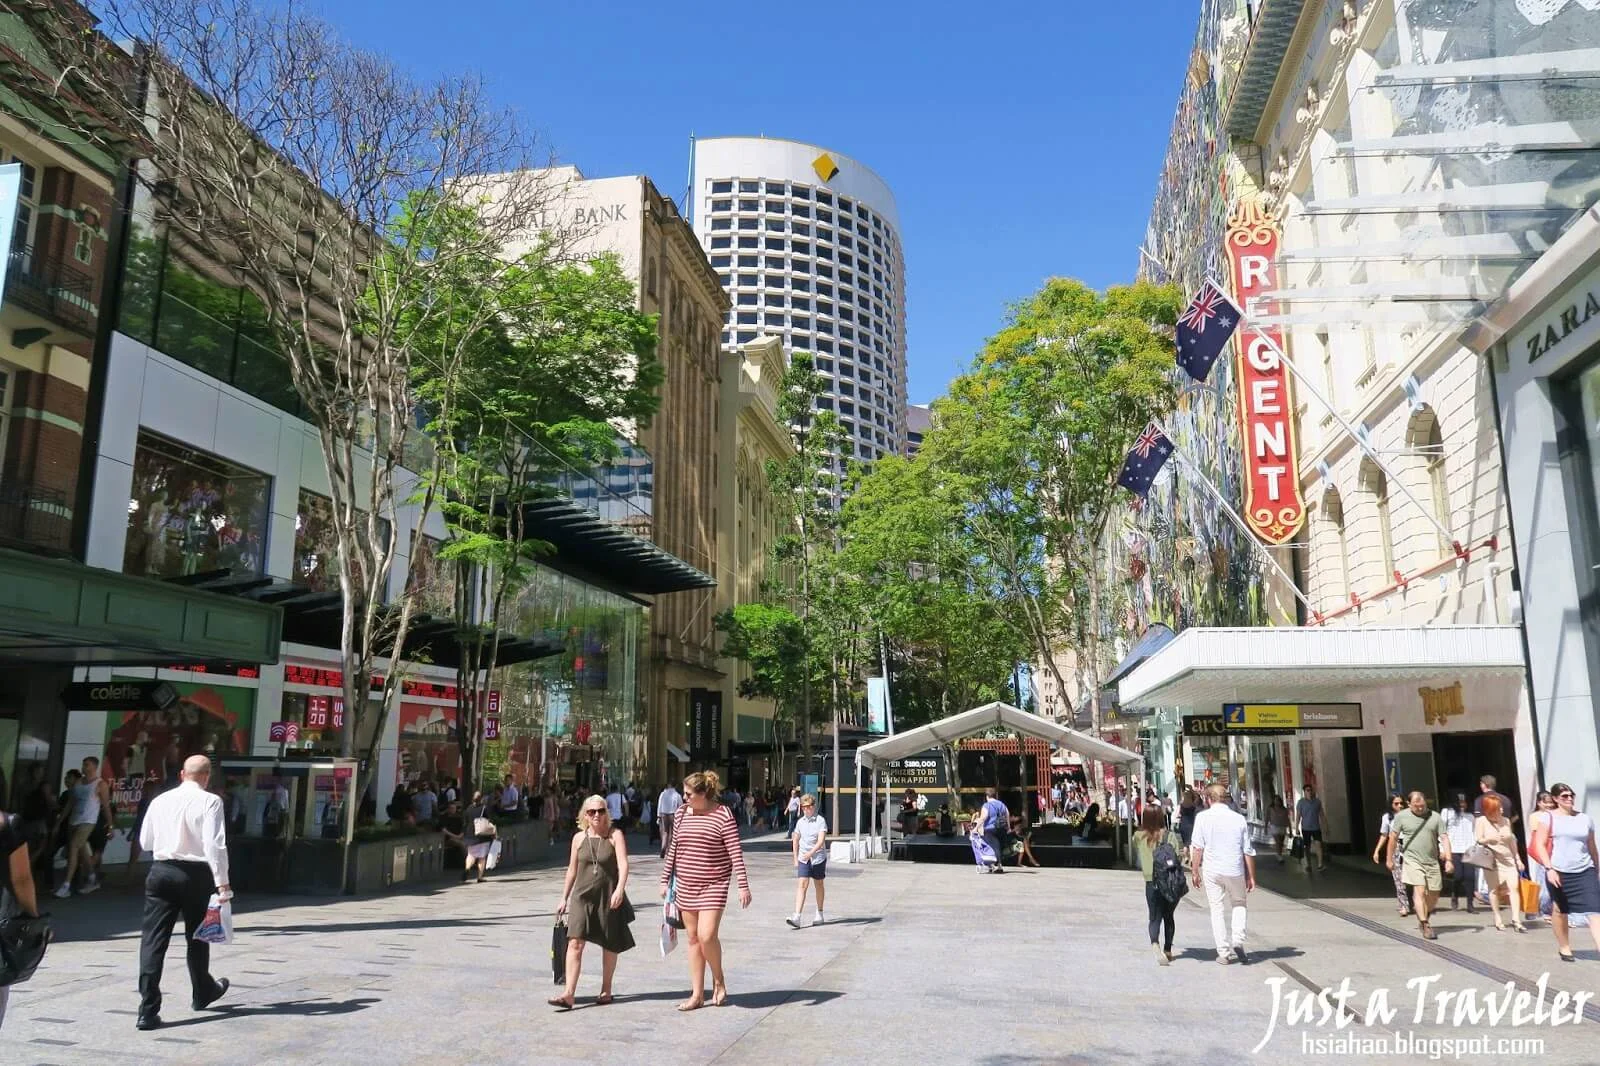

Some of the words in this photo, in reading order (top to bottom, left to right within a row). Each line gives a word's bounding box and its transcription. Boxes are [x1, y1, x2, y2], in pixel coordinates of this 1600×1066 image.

[574, 203, 628, 225] BANK
[1527, 292, 1600, 365] ZARA
[1241, 255, 1285, 502] REGENT
[1303, 712, 1338, 721] brisbane
[917, 768, 926, 776] TO
[927, 768, 937, 776] BE
[127, 776, 146, 790] JOY
[881, 776, 937, 784] UNWRAPPED!
[112, 790, 142, 802] NIQLO
